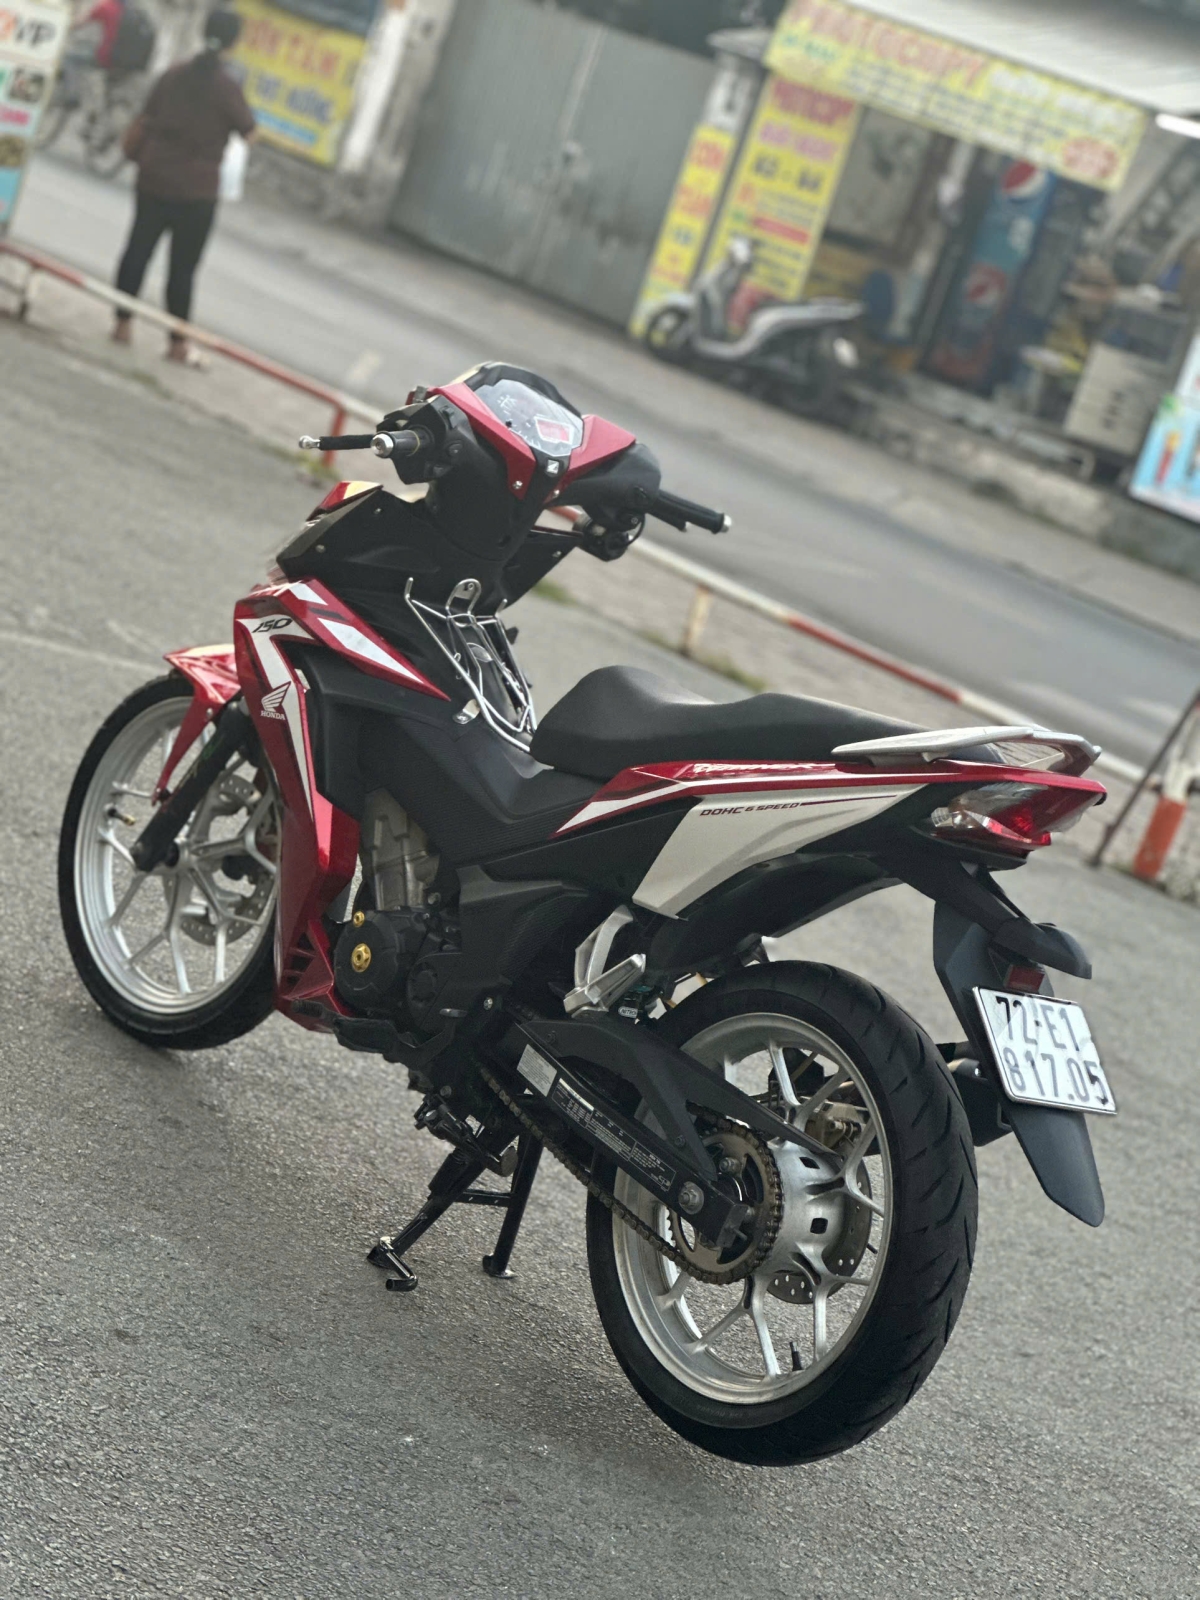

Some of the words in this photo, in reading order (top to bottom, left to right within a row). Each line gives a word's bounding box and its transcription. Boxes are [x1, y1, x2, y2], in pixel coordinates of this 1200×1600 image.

[252, 618, 293, 633] 150
[260, 710, 286, 720] HONDA
[700, 806, 744, 817] DOHC
[755, 802, 800, 811] SPEED
[995, 995, 1080, 1052] 72-E1
[1003, 1046, 1109, 1105] 817.05
